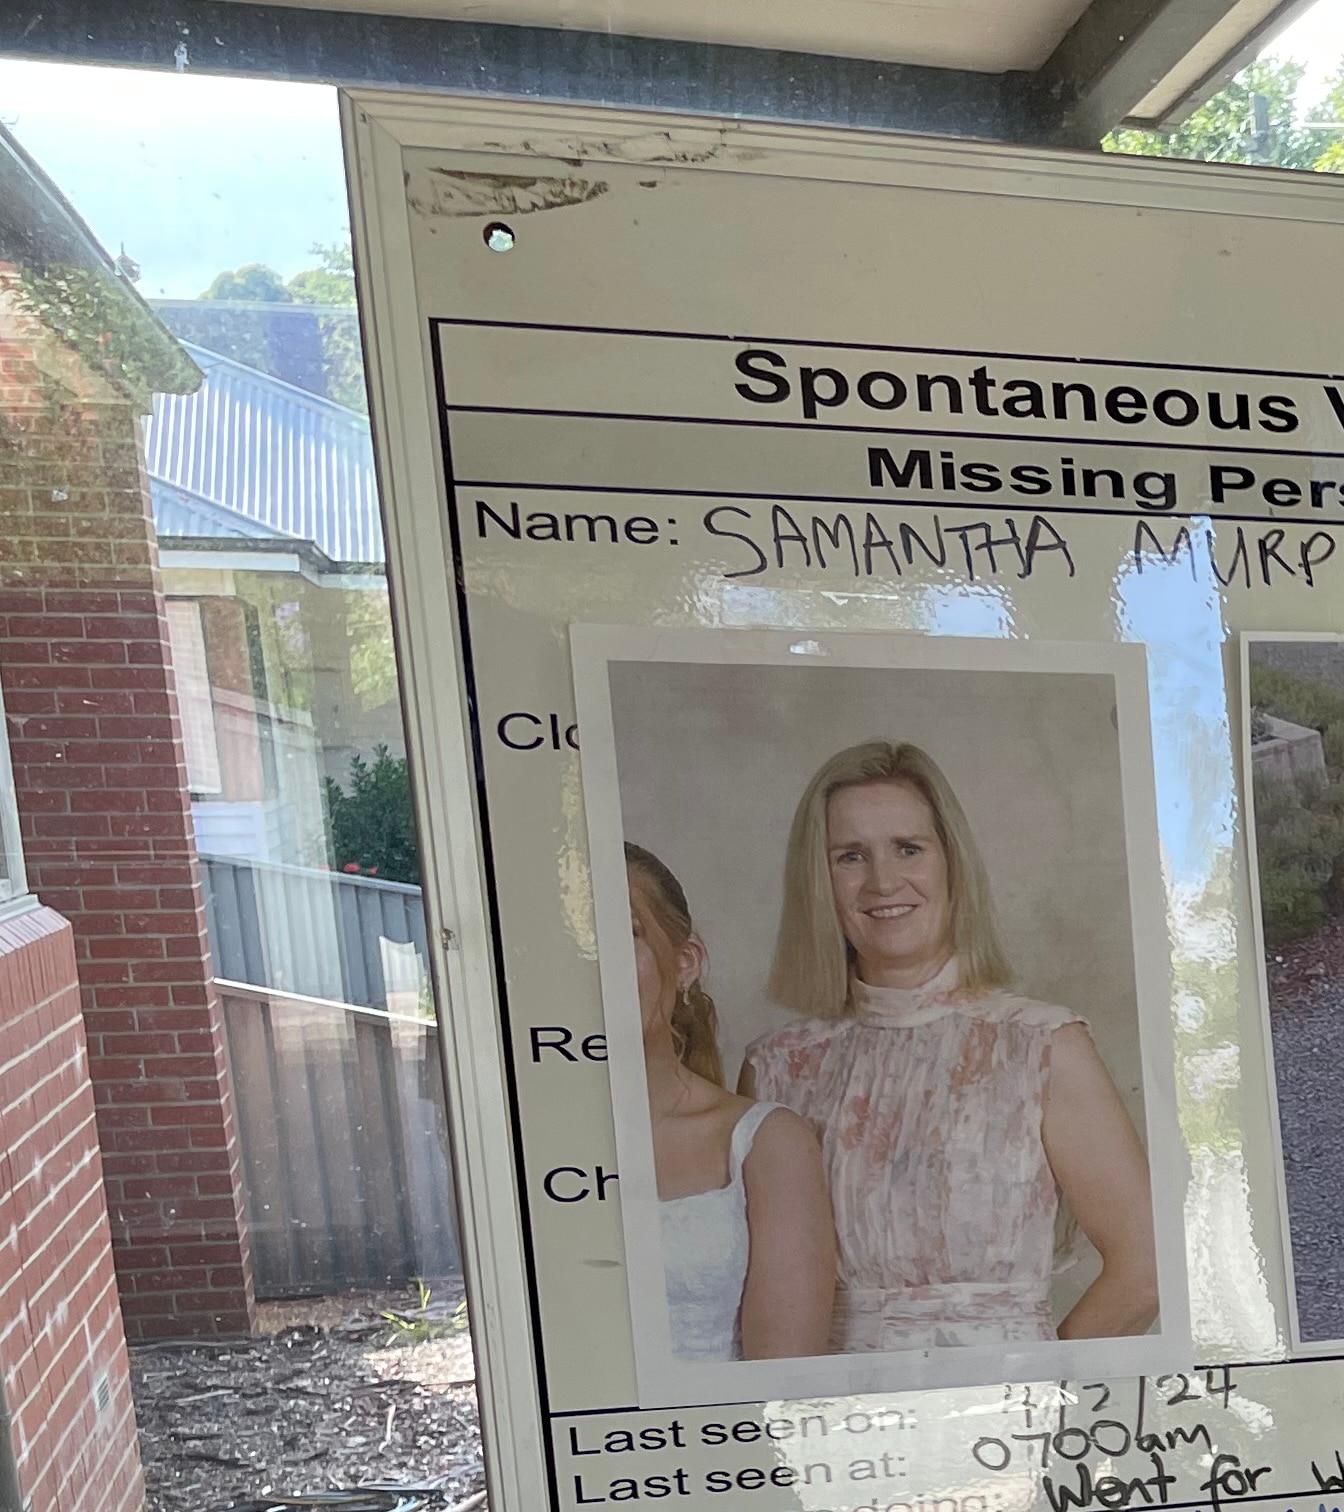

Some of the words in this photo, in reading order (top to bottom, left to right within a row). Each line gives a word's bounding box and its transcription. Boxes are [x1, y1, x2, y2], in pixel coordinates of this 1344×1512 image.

[734, 348, 1299, 434] Spontaneous
[867, 448, 1178, 511] Missing
[474, 501, 680, 546] Name:
[703, 505, 1075, 580] SAMANTHA
[569, 1419, 687, 1456] Last
[700, 1412, 828, 1445] seen
[845, 1406, 917, 1435] on:
[574, 1467, 690, 1504] Last
[705, 1458, 833, 1494] seen
[848, 1453, 907, 1482] at:
